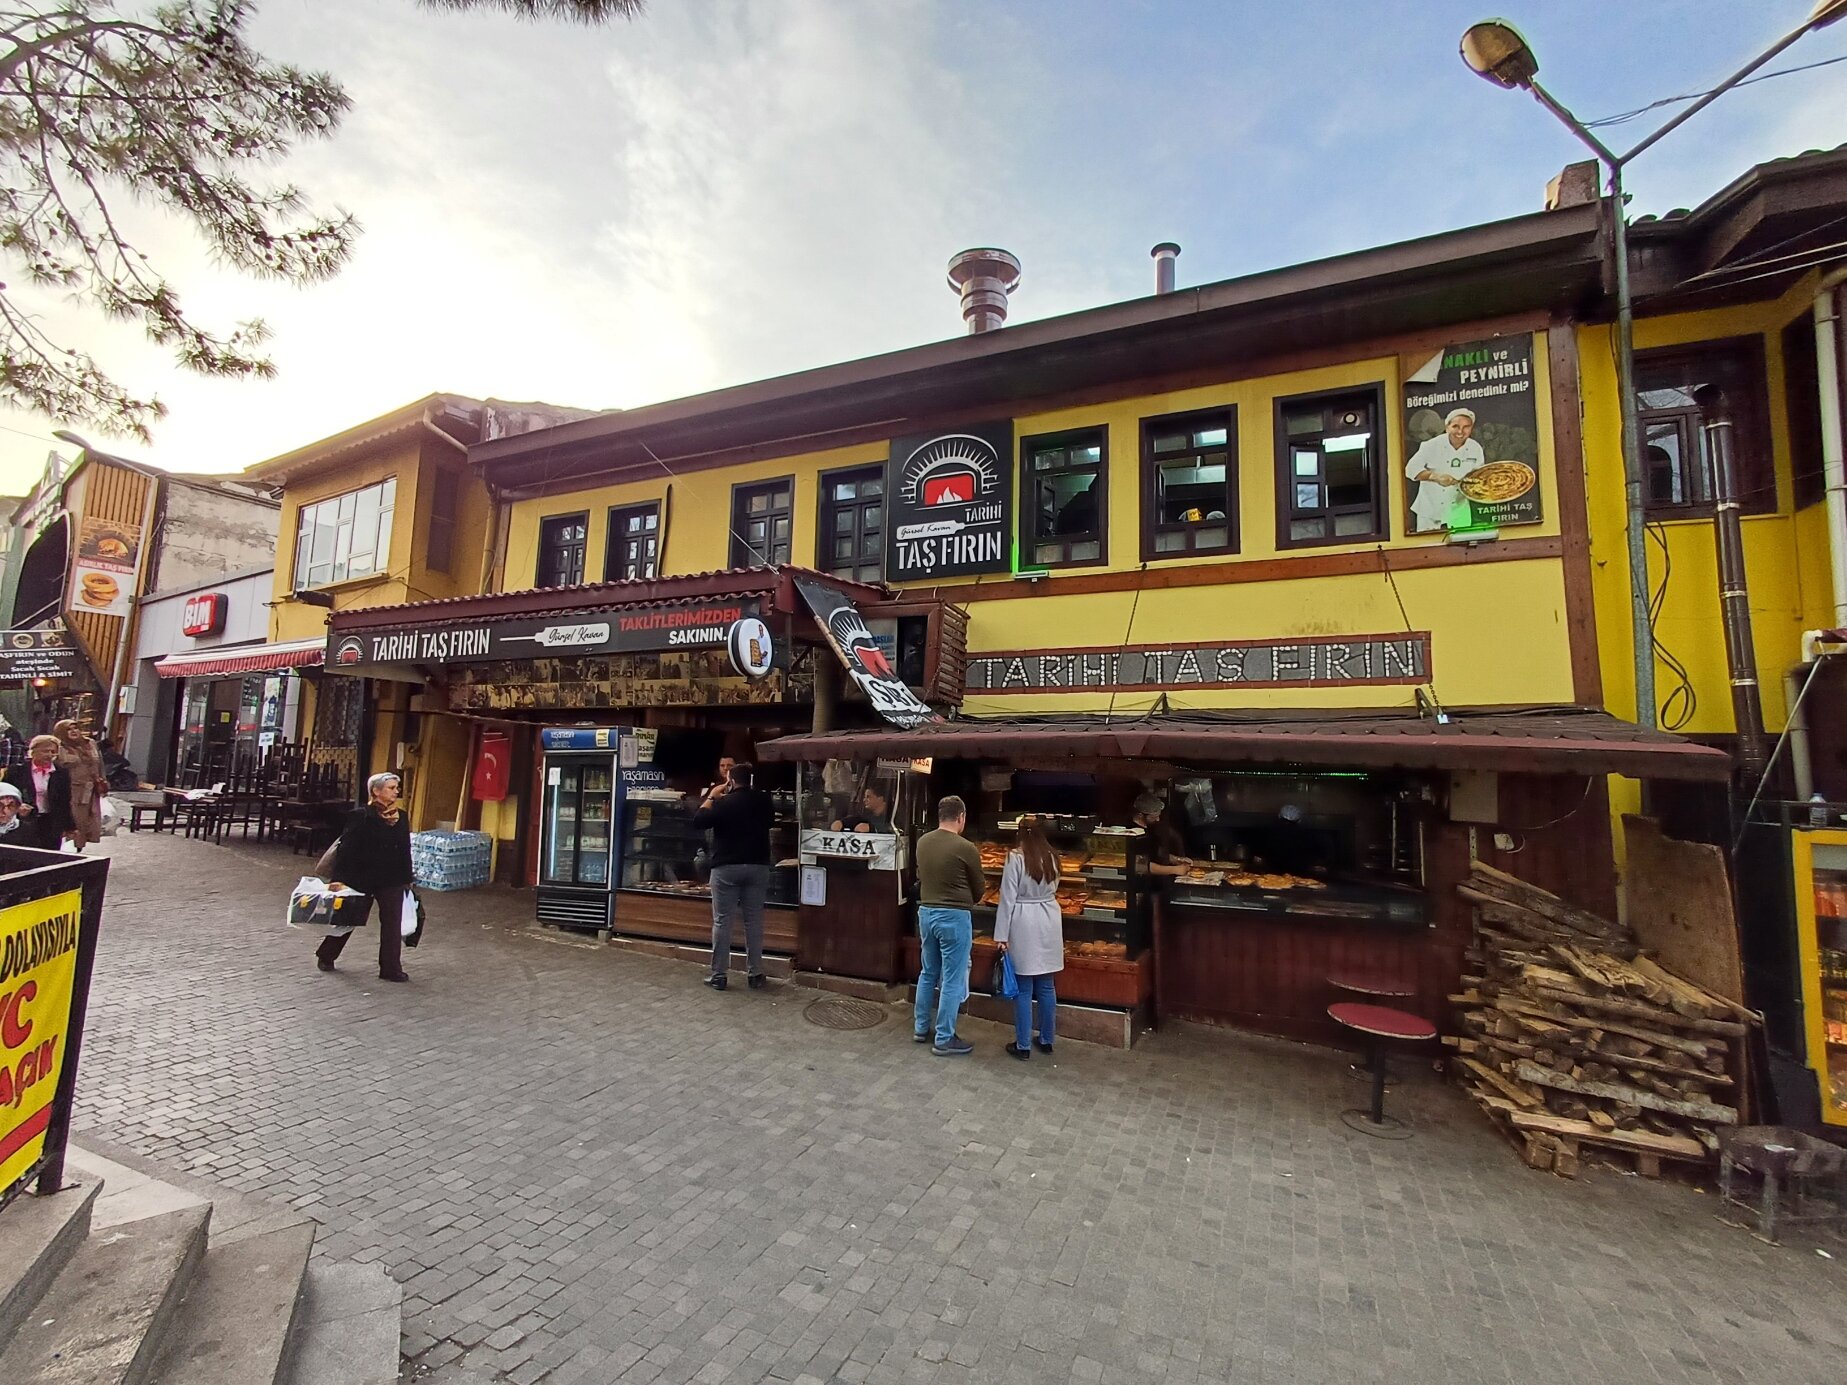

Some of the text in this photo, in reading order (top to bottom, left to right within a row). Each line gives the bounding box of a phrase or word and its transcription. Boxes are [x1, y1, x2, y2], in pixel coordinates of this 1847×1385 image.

[1441, 349, 1508, 369] NAKLI ve
[1460, 358, 1528, 384] PEYNİRLİ
[1459, 383, 1507, 400] denediniz
[965, 500, 1002, 522] TARİHİ
[1477, 502, 1533, 514] TARİHİ TAŞ
[1491, 513, 1518, 522] FIRIN
[896, 531, 1002, 573] TAŞ FIRIN
[619, 608, 742, 631] TAKLİTLERİMİZDEN
[372, 628, 491, 663] TARİHİ TAŞ FIRIN
[15, 658, 55, 666] ateşinde
[975, 653, 1121, 689] TARİHİ
[1271, 641, 1415, 681] FIRIN
[822, 836, 876, 855] KASA
[0, 911, 76, 984] DOLAYISIYLA
